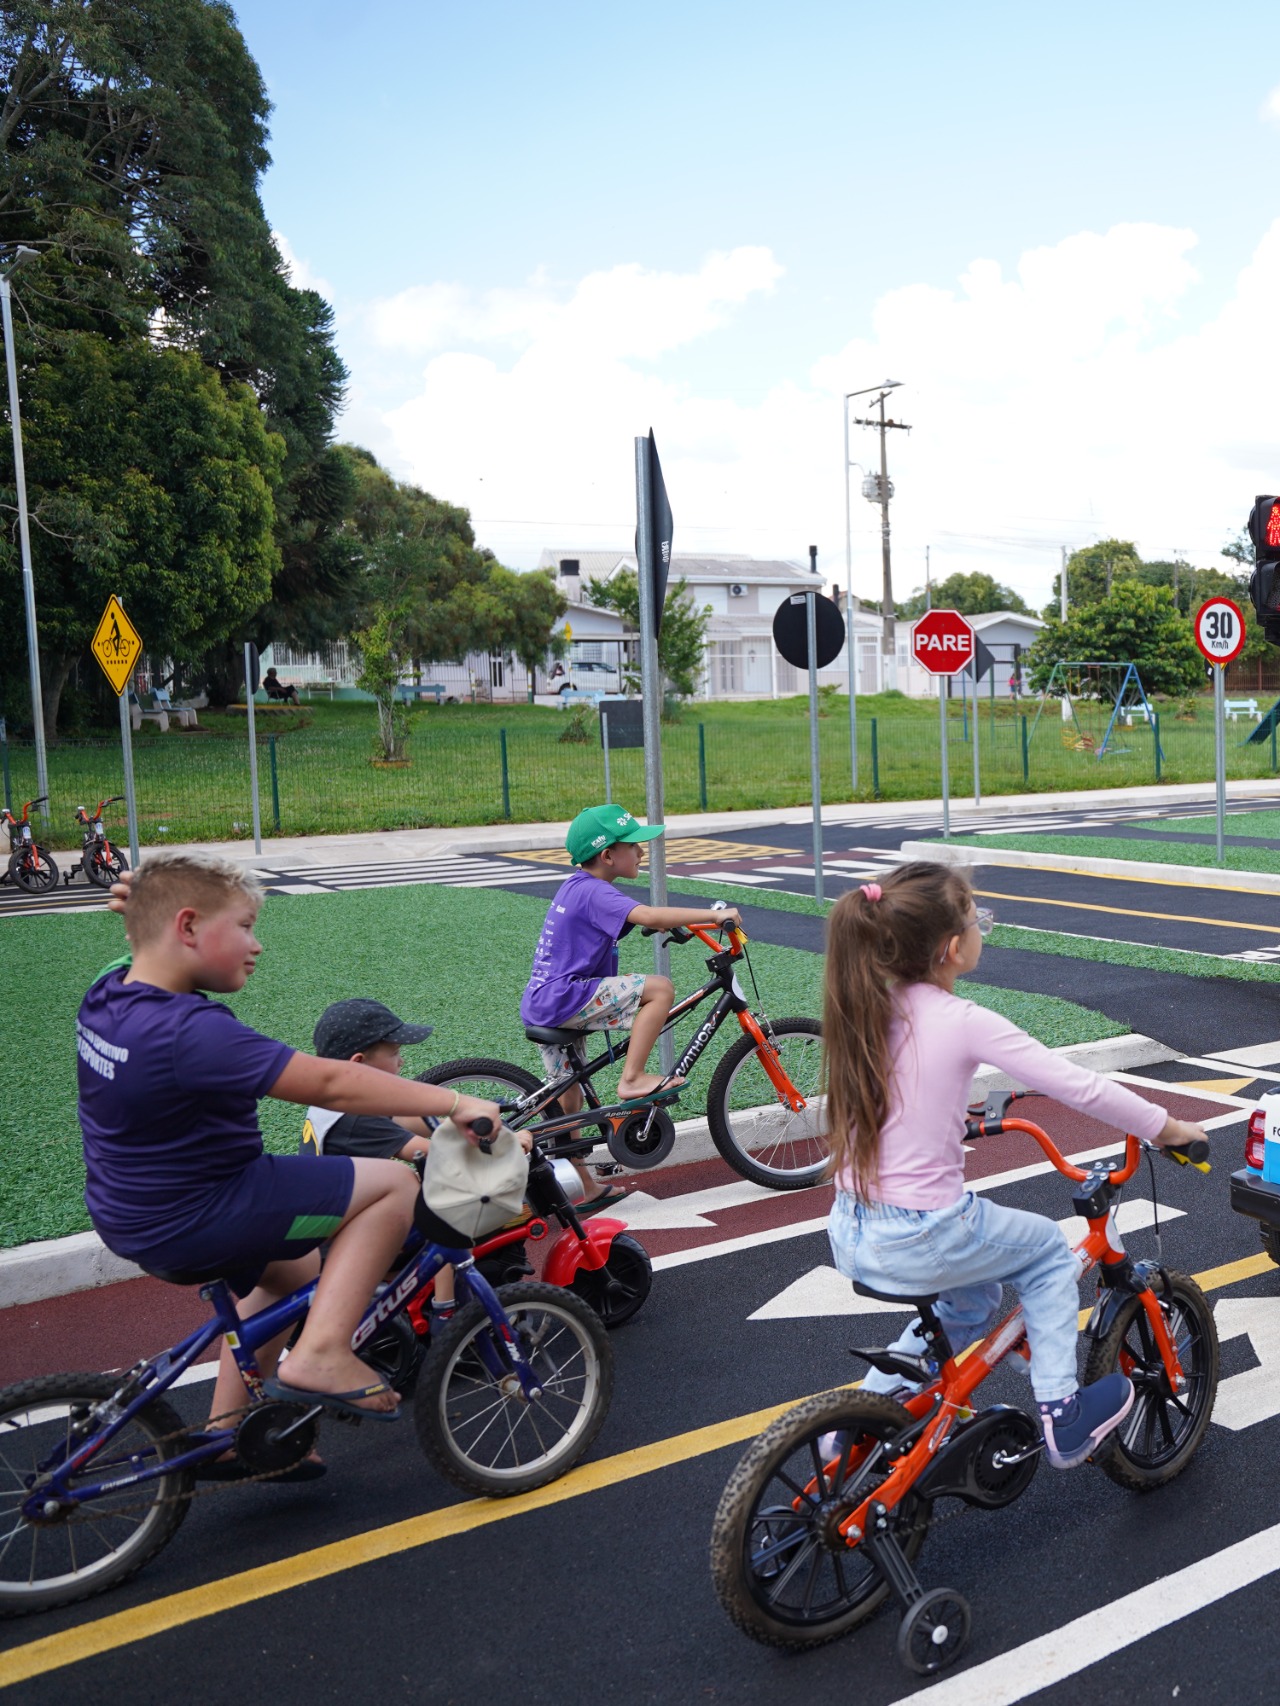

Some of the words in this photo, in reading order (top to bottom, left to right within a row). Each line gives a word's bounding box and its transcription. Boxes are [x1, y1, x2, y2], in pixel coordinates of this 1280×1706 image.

[1206, 611, 1233, 639] 30
[915, 634, 970, 651] PARE
[675, 1023, 717, 1077] NATHOR
